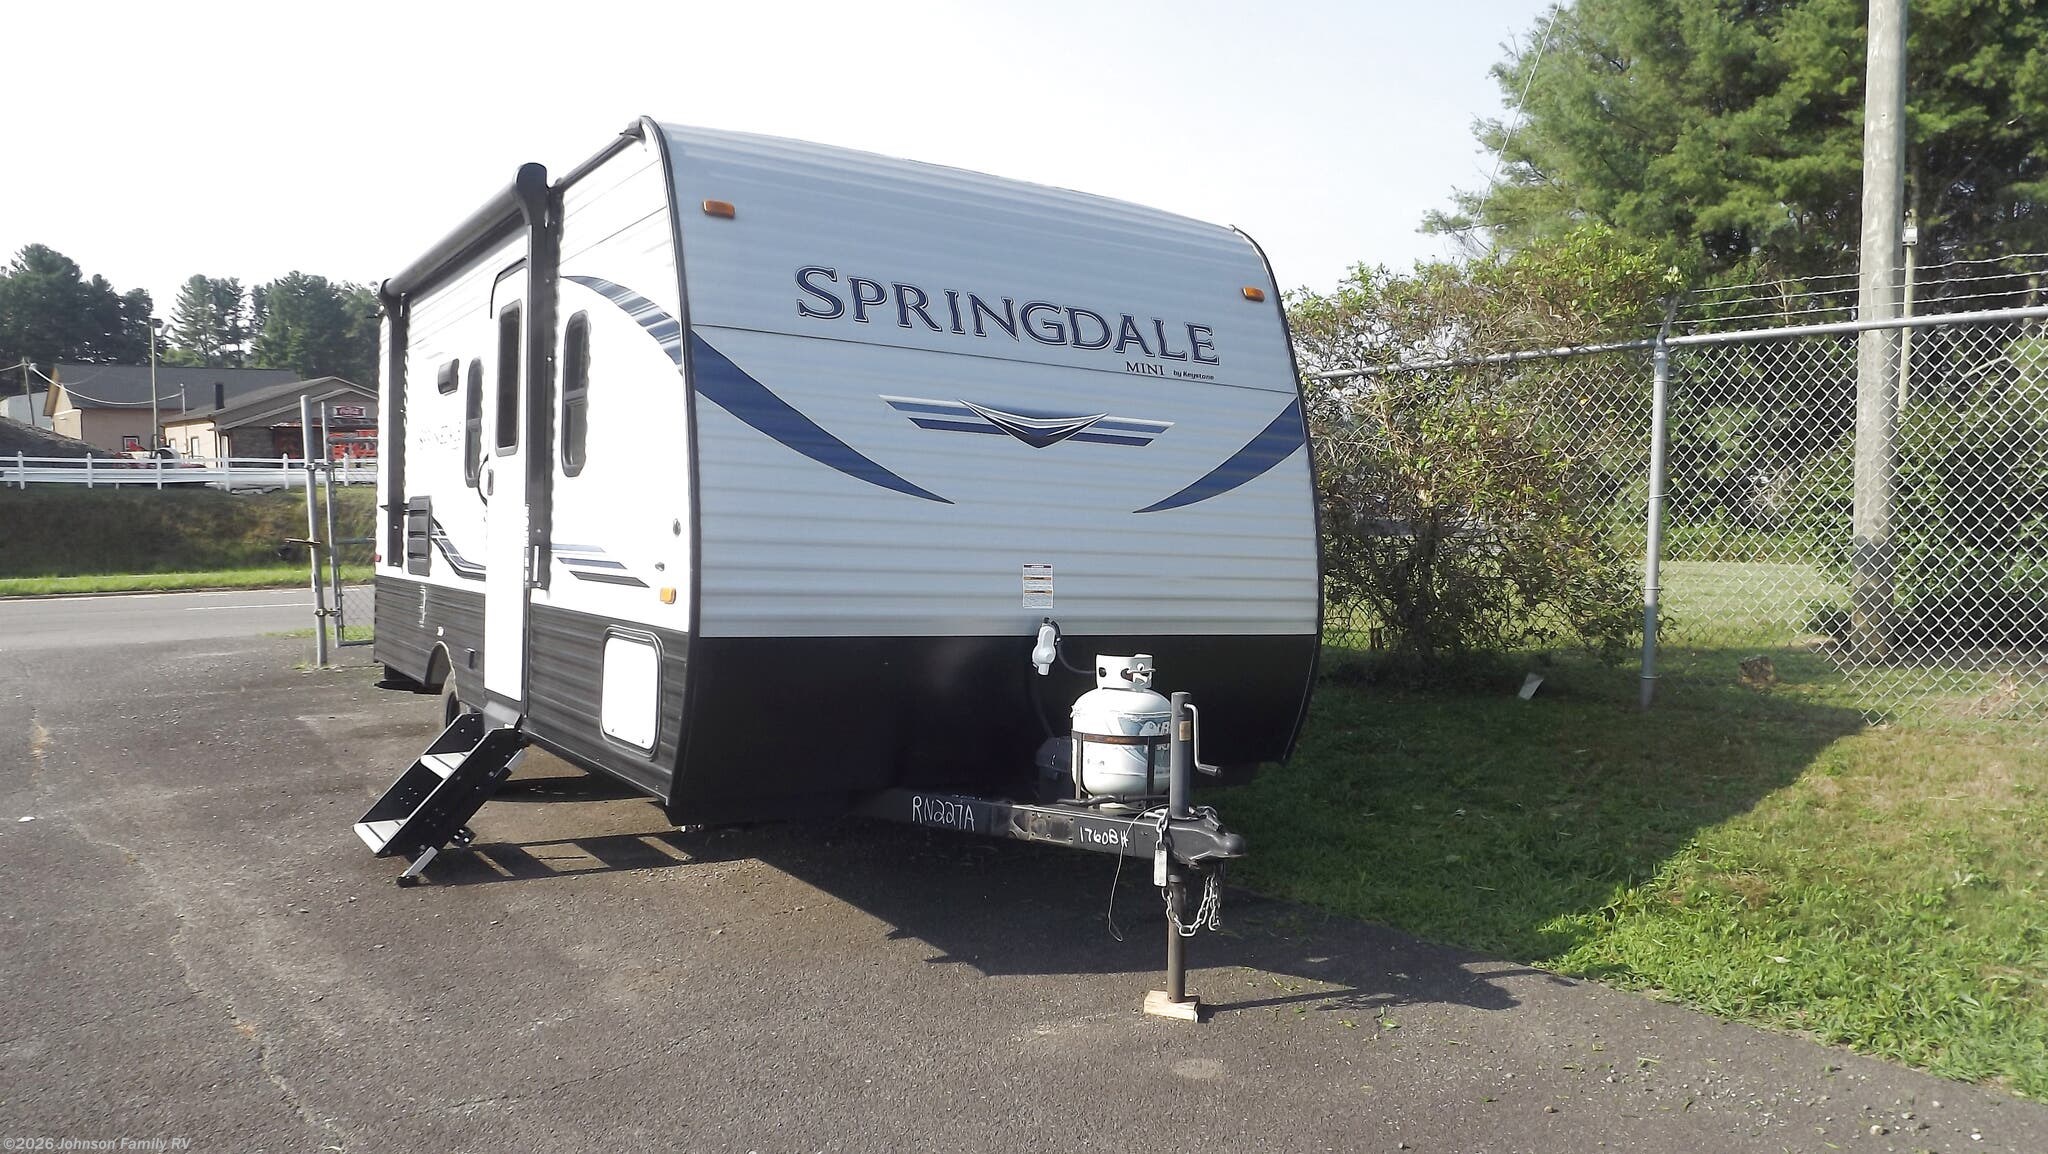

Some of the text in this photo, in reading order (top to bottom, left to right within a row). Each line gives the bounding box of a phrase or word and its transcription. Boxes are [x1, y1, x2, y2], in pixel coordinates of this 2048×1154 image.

[795, 265, 1220, 366] SPRINGDALE
[1126, 361, 1164, 376] MINI
[1173, 369, 1215, 380] by Keystone
[912, 795, 976, 832] RN227A
[1079, 826, 1129, 848] 1760BH
